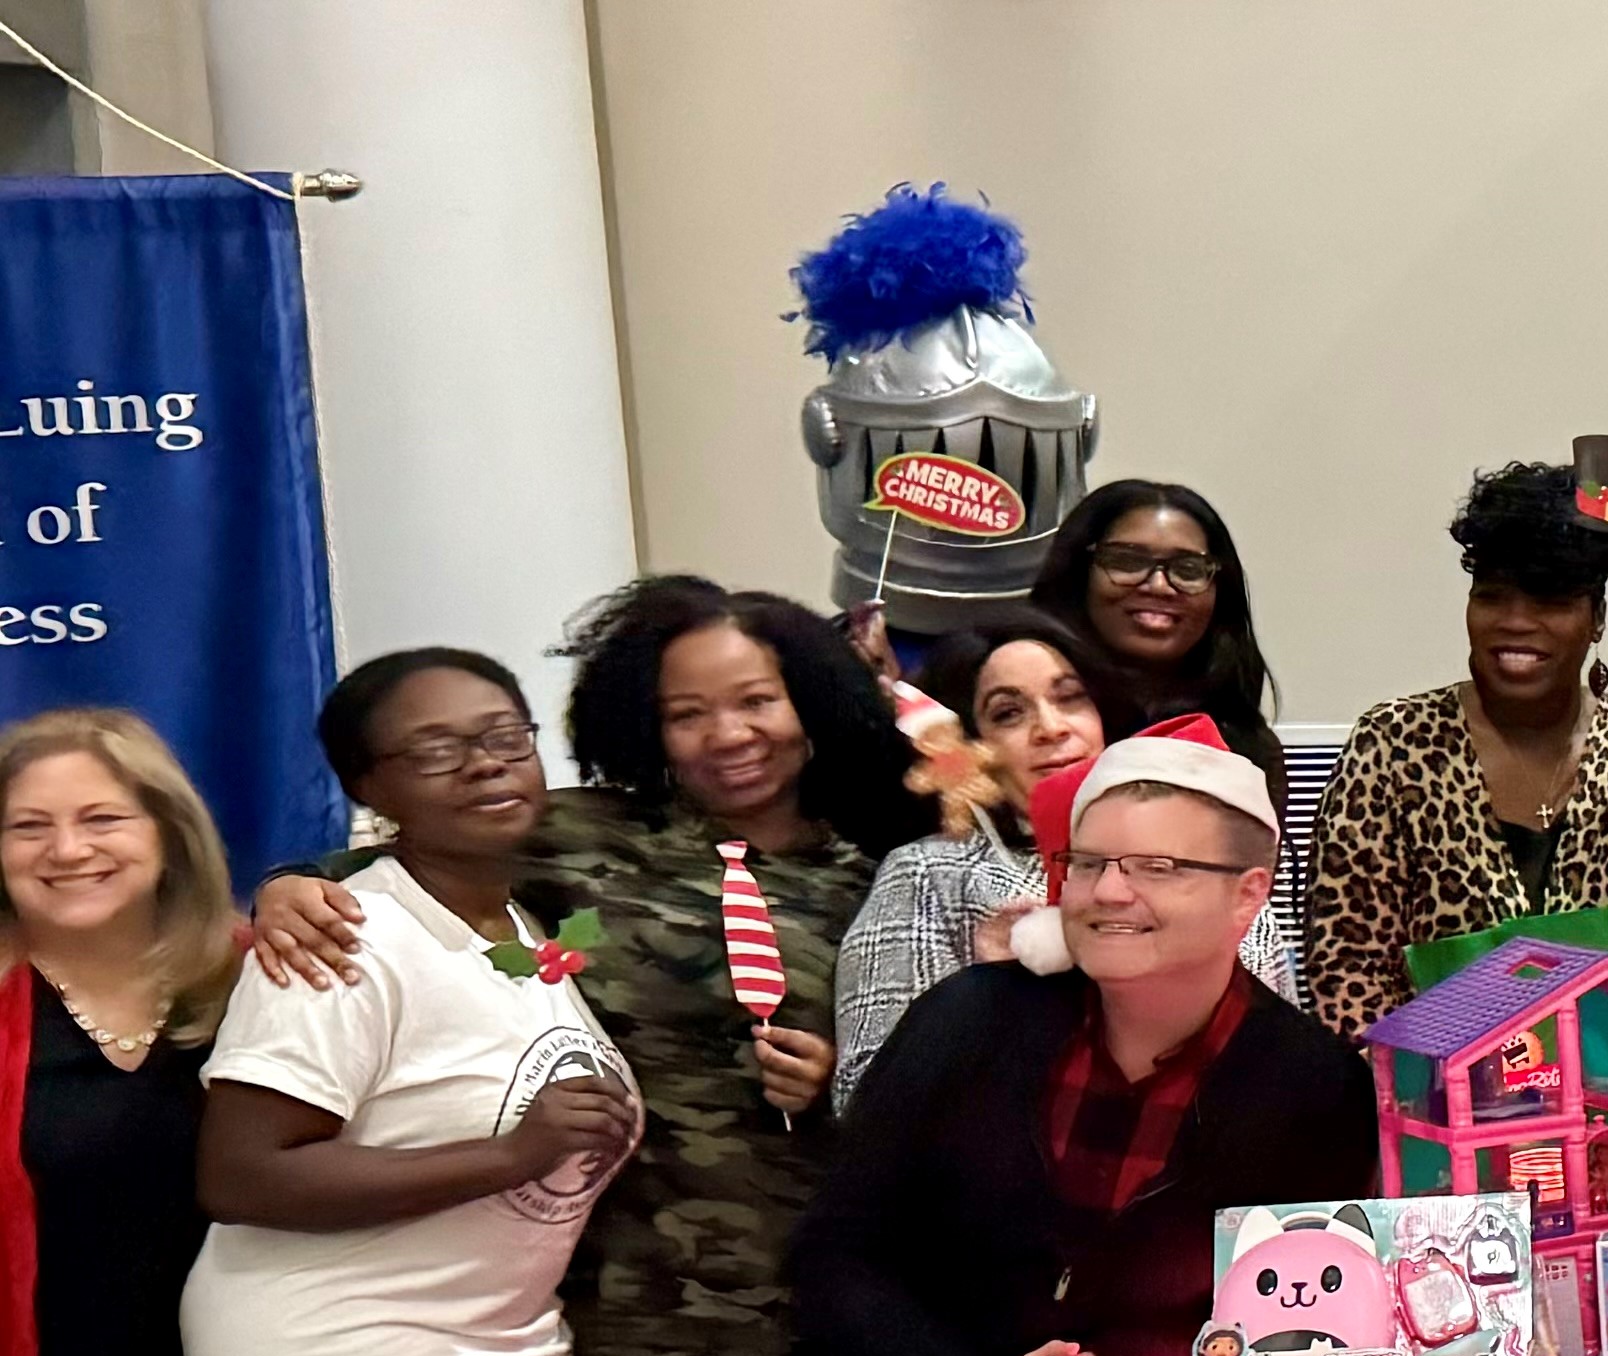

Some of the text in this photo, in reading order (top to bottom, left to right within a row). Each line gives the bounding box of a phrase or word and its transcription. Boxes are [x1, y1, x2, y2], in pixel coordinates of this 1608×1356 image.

[885, 478, 1009, 530] CHRISTMAS
[905, 460, 999, 505] MERRY
[28, 483, 106, 545] of
